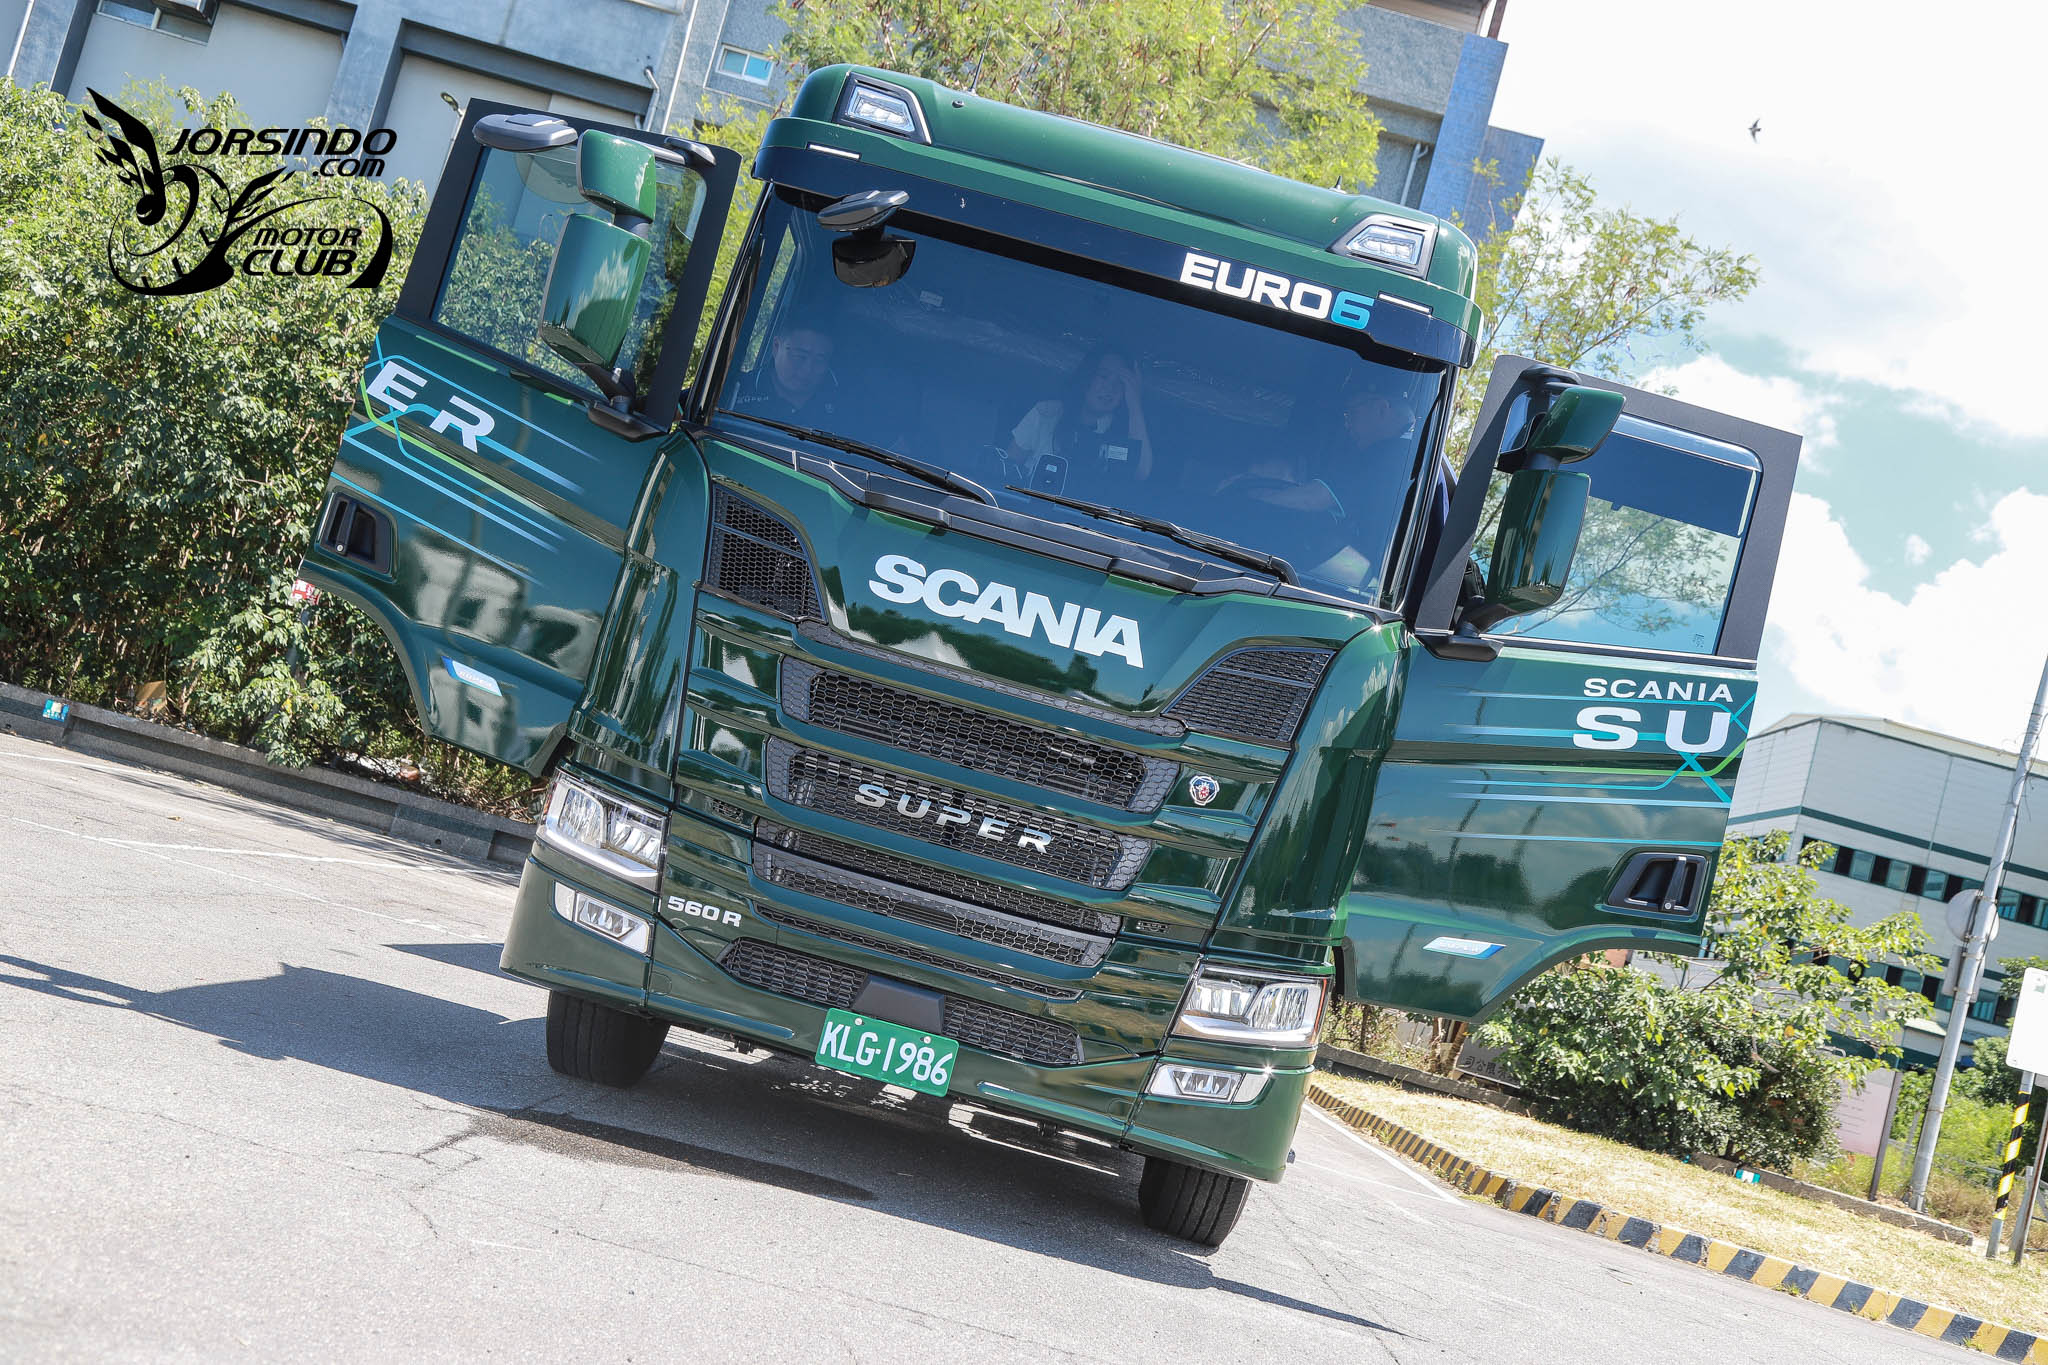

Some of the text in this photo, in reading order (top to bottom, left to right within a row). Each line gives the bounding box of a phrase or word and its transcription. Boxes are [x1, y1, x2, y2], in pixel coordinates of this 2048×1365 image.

[869, 554, 1144, 669] SCANIA
[1583, 678, 1734, 703] SCANIA
[854, 783, 1055, 854] SUPER
[667, 895, 742, 928] 560 R
[819, 1021, 953, 1086] KLG-1986
